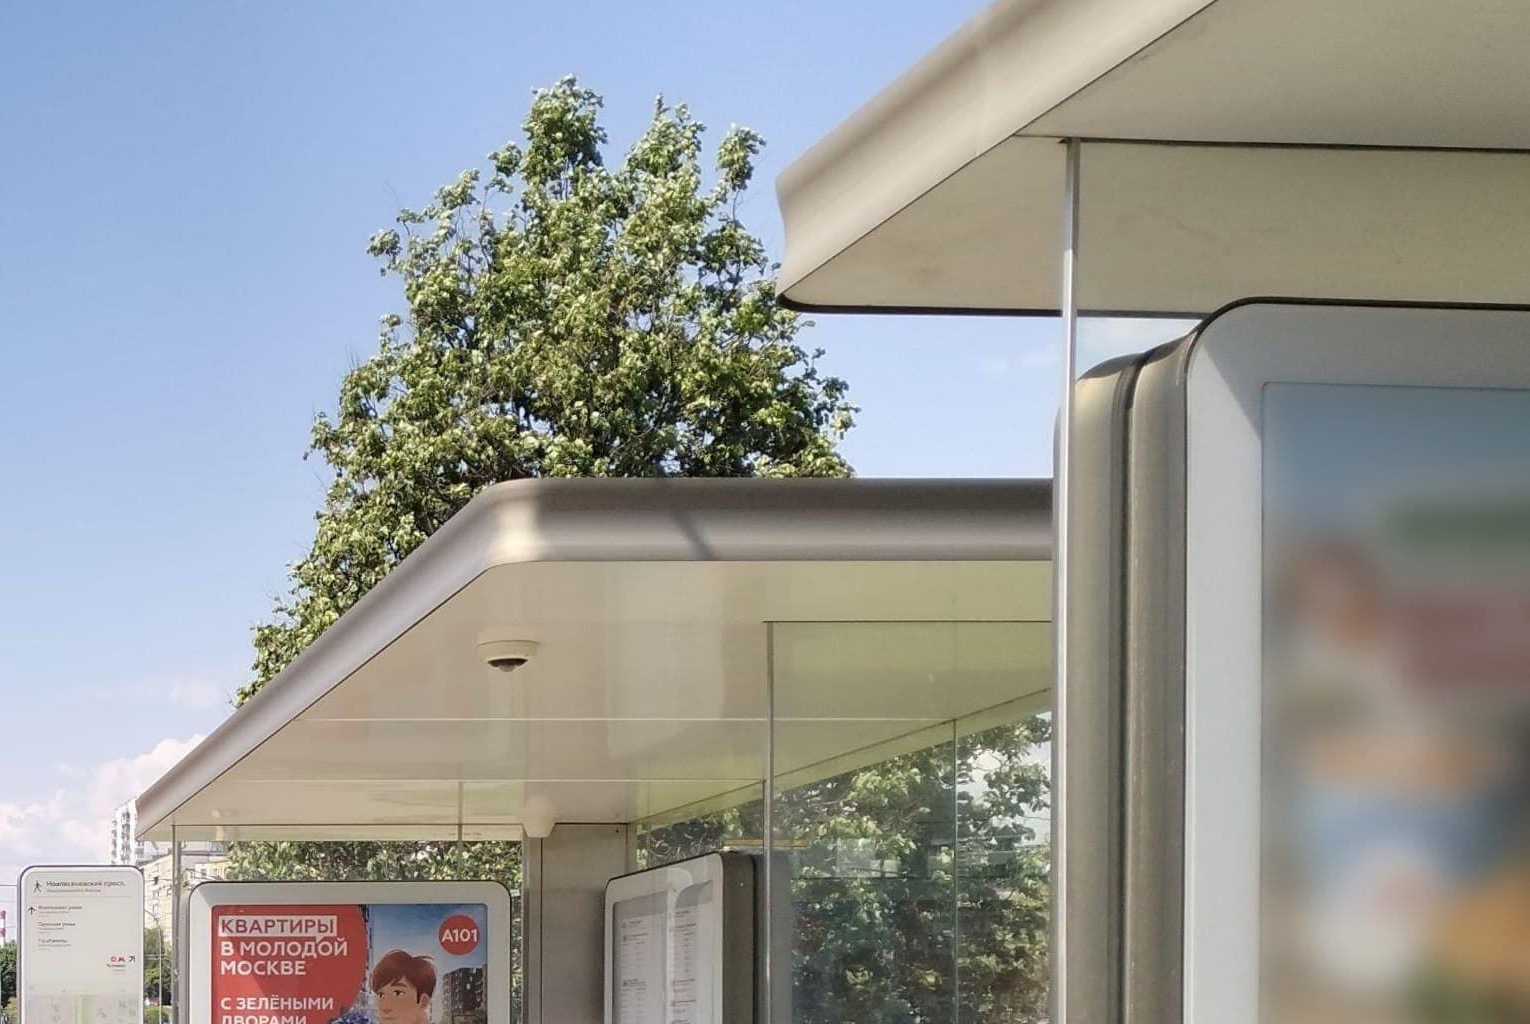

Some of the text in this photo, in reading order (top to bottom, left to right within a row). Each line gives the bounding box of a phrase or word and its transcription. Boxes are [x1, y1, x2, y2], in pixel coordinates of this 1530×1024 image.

[221, 918, 334, 933] КВАРТИРЫ
[221, 937, 348, 957] В МОЛОДОЙ
[221, 961, 306, 976] МОСКВЕ
[221, 995, 334, 1010] С ЗЕЛЁНЫМИ
